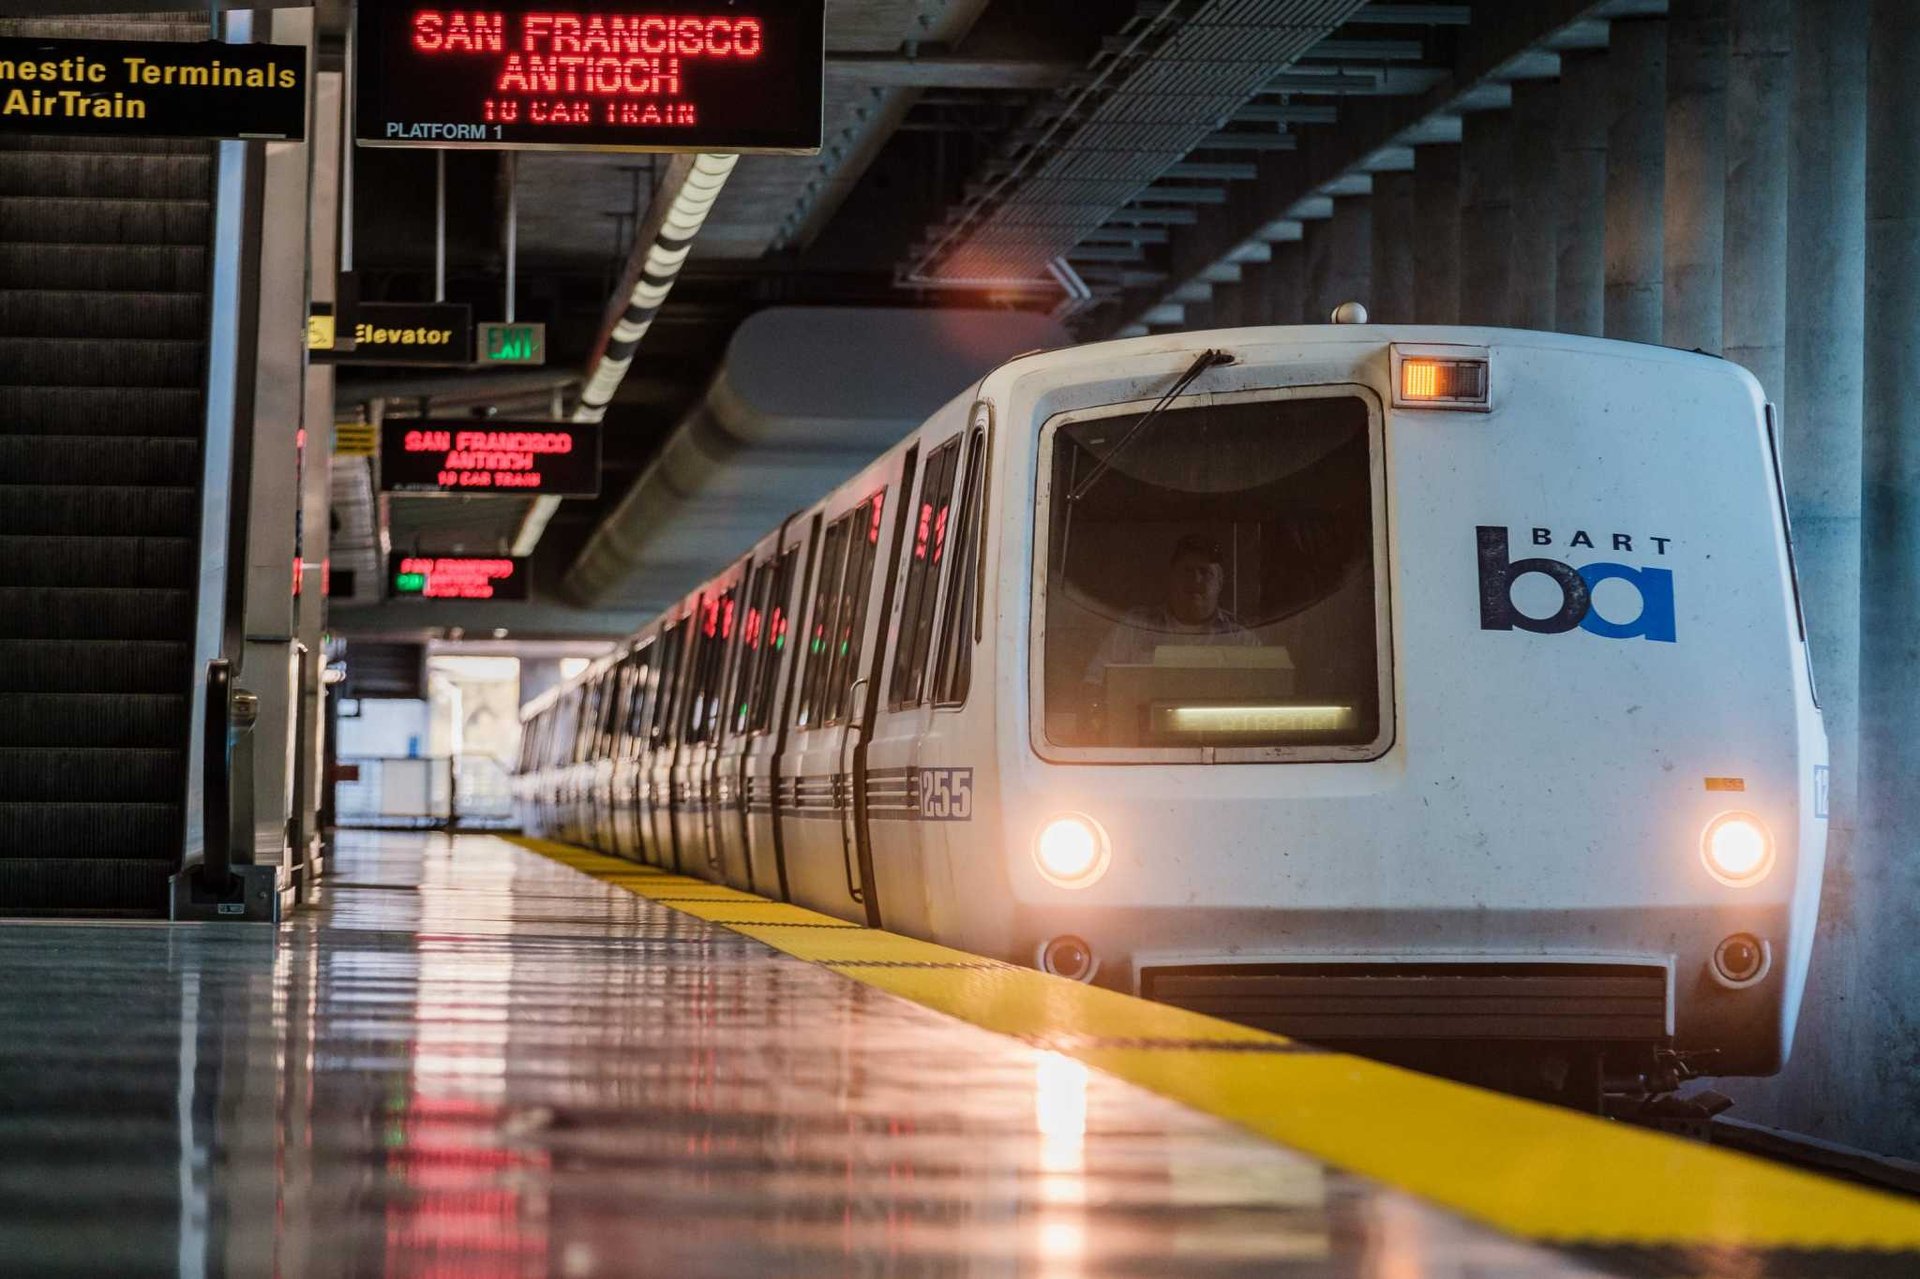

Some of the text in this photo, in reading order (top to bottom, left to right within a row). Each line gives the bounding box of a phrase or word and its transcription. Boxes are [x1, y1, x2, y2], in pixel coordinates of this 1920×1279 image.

[413, 14, 762, 55] SAN FRANCISCO
[123, 58, 296, 88] Terminals
[499, 55, 680, 94] ANTIOCH
[3, 89, 146, 119] AirTrain
[386, 122, 503, 140] PLATFORM 1
[355, 324, 453, 345] Elevator
[404, 430, 572, 454] SAN FRANCISCO
[1531, 527, 1672, 556] BART
